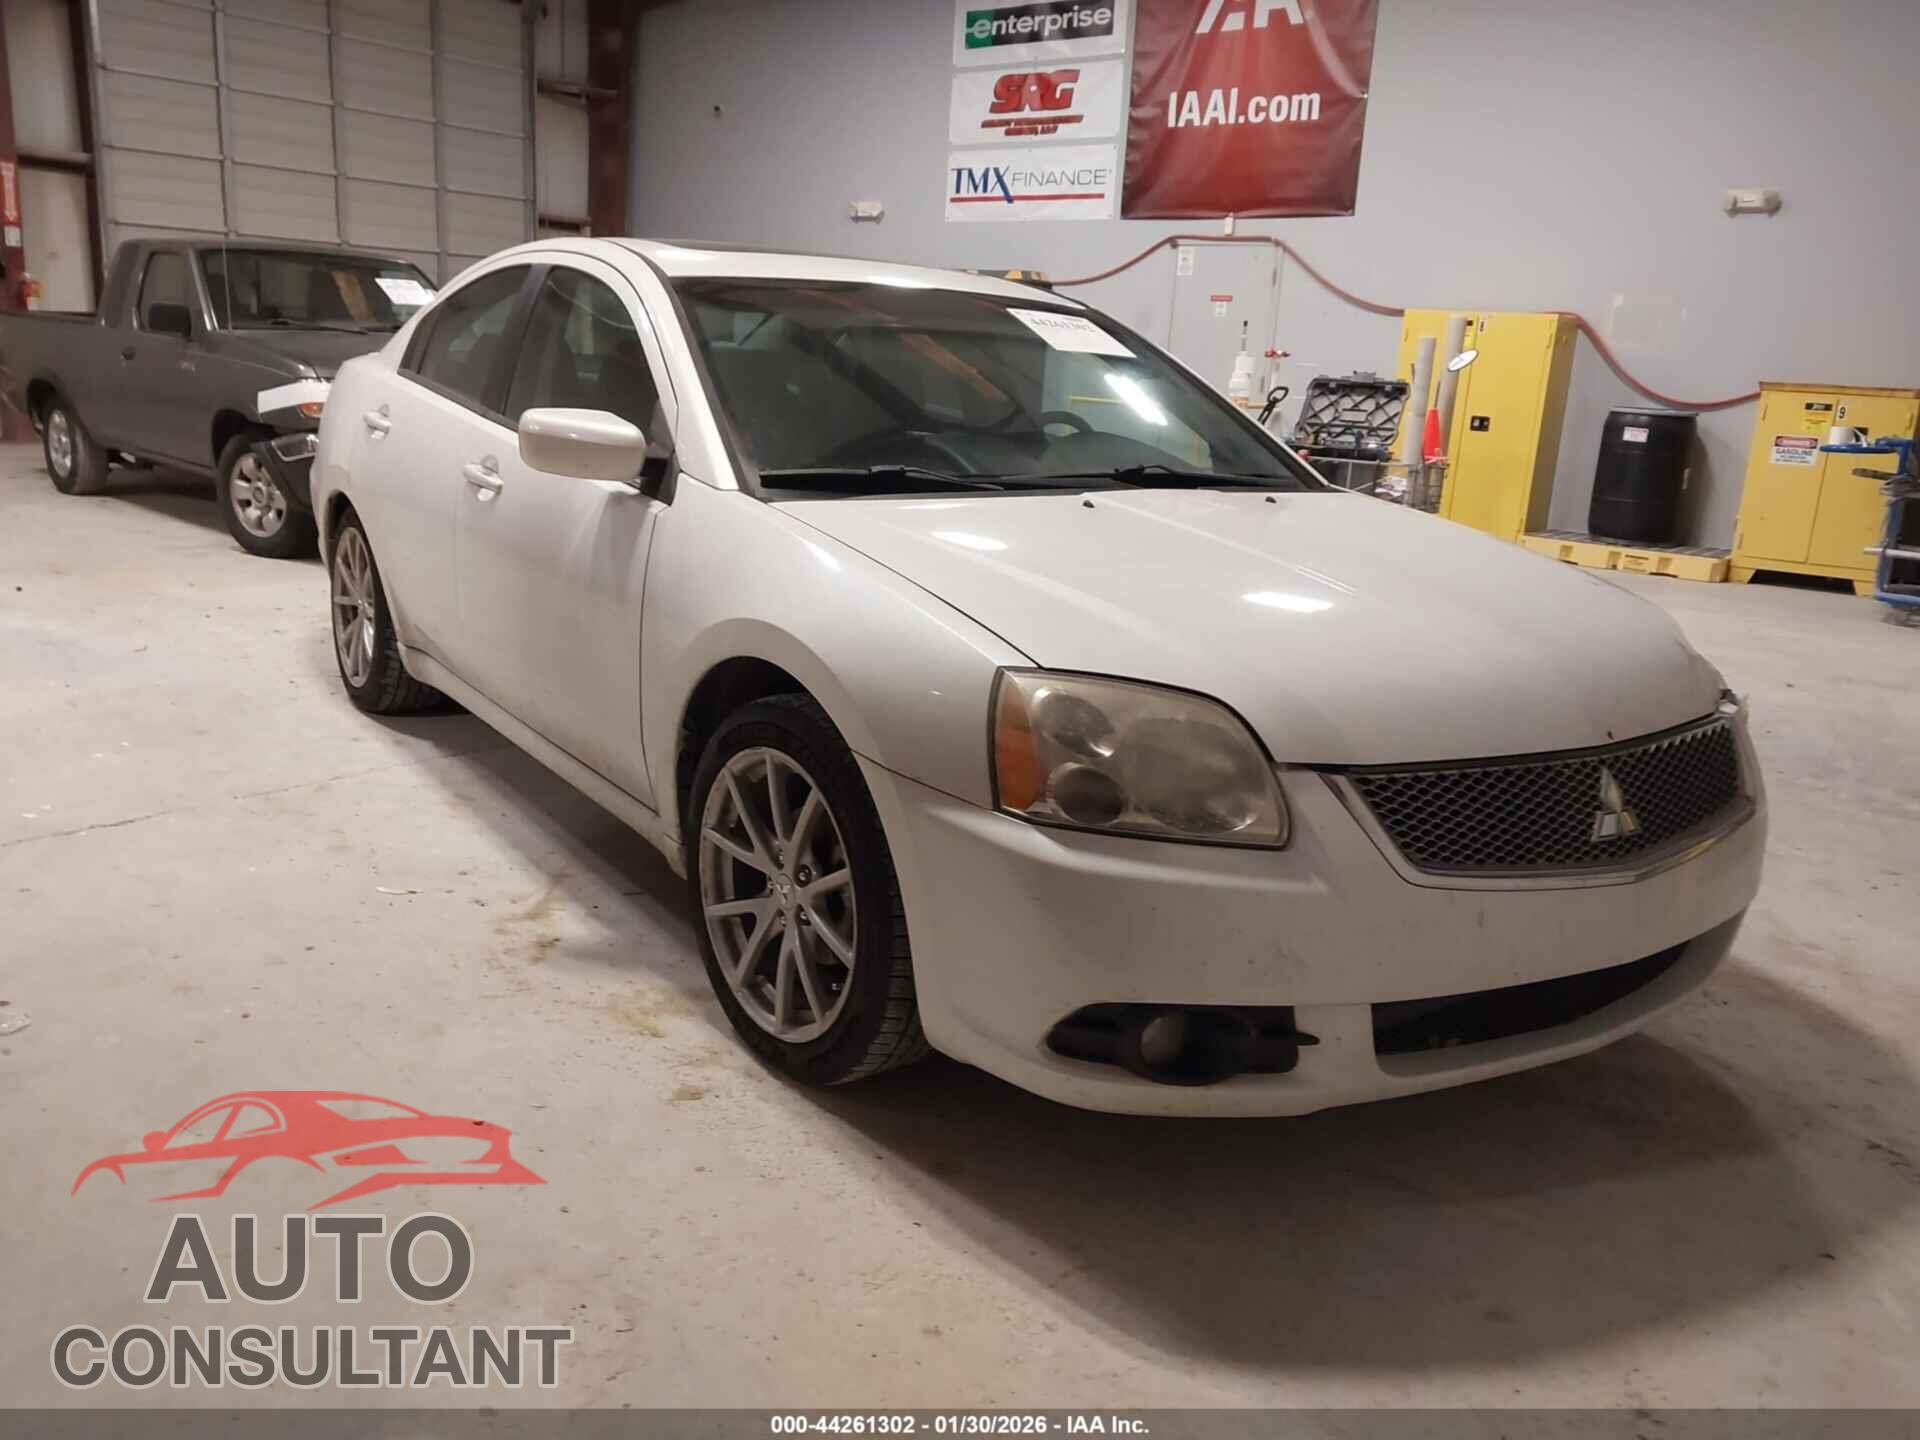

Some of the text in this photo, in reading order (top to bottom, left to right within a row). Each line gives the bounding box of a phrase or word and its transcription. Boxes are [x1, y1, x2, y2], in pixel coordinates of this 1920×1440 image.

[966, 5, 1112, 38] enterprise
[1167, 87, 1321, 128] IAAI.com
[951, 165, 1107, 204] TMX FINANCE
